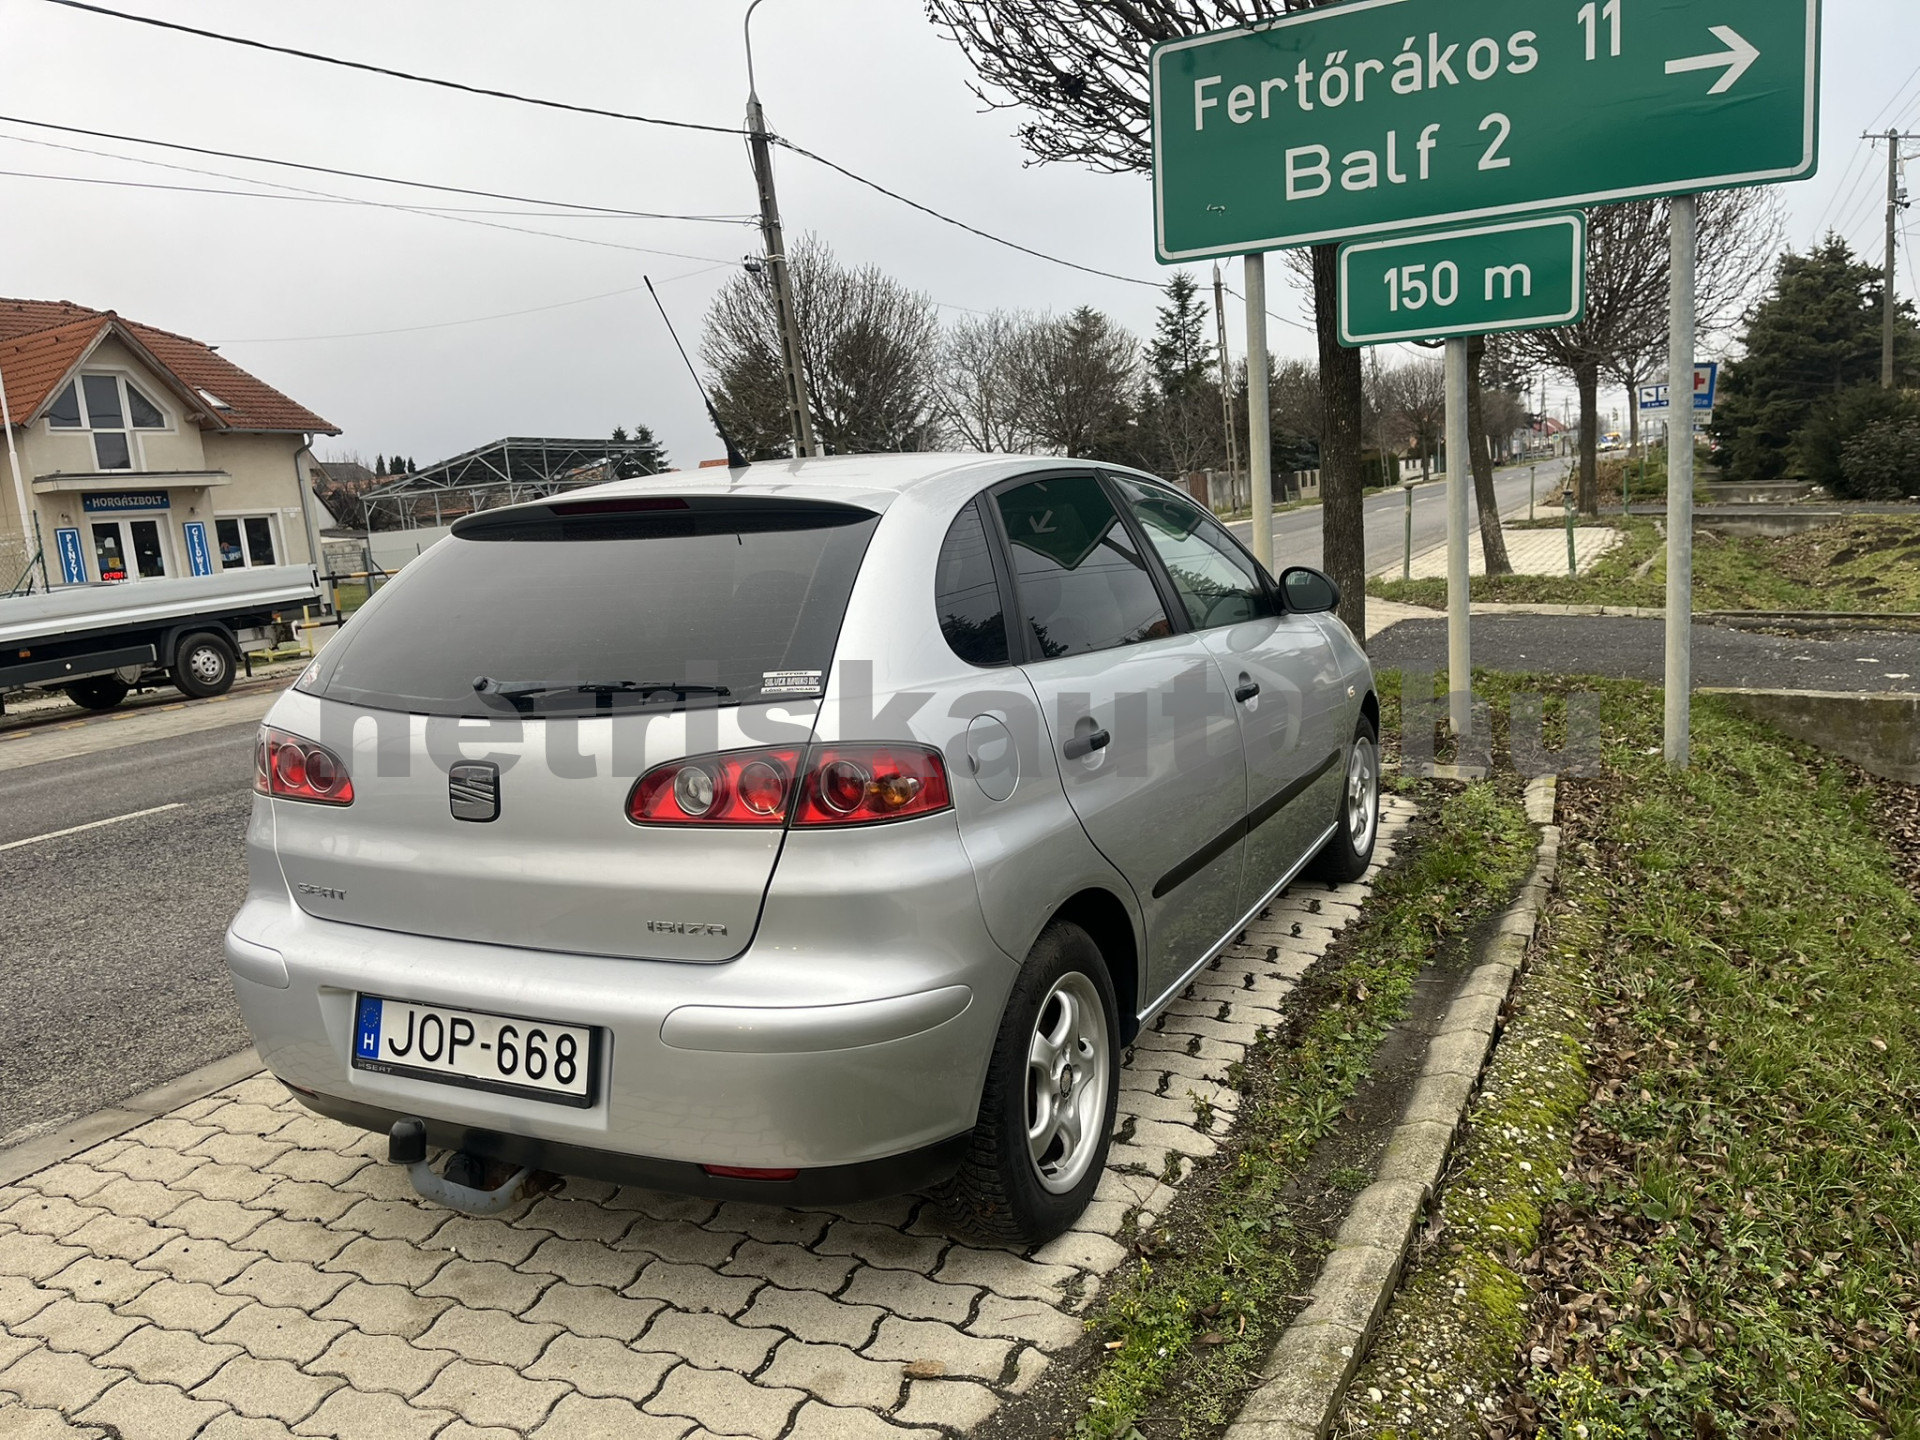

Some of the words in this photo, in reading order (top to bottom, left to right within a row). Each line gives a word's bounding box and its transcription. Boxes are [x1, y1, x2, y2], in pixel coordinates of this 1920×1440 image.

[1194, 30, 1539, 131] Fertőrákos
[1577, 0, 1621, 61] 11
[1285, 123, 1440, 200] Balf
[1478, 112, 1512, 171] 2
[1384, 259, 1459, 312] 150
[1484, 262, 1531, 301] m
[92, 494, 162, 508] HORGÁSZBOLT
[298, 882, 347, 900] SEAT
[647, 920, 728, 936] IBIZA
[363, 1032, 374, 1050] H
[388, 1010, 577, 1085] JOP-668
[365, 1063, 393, 1074] SEAT
